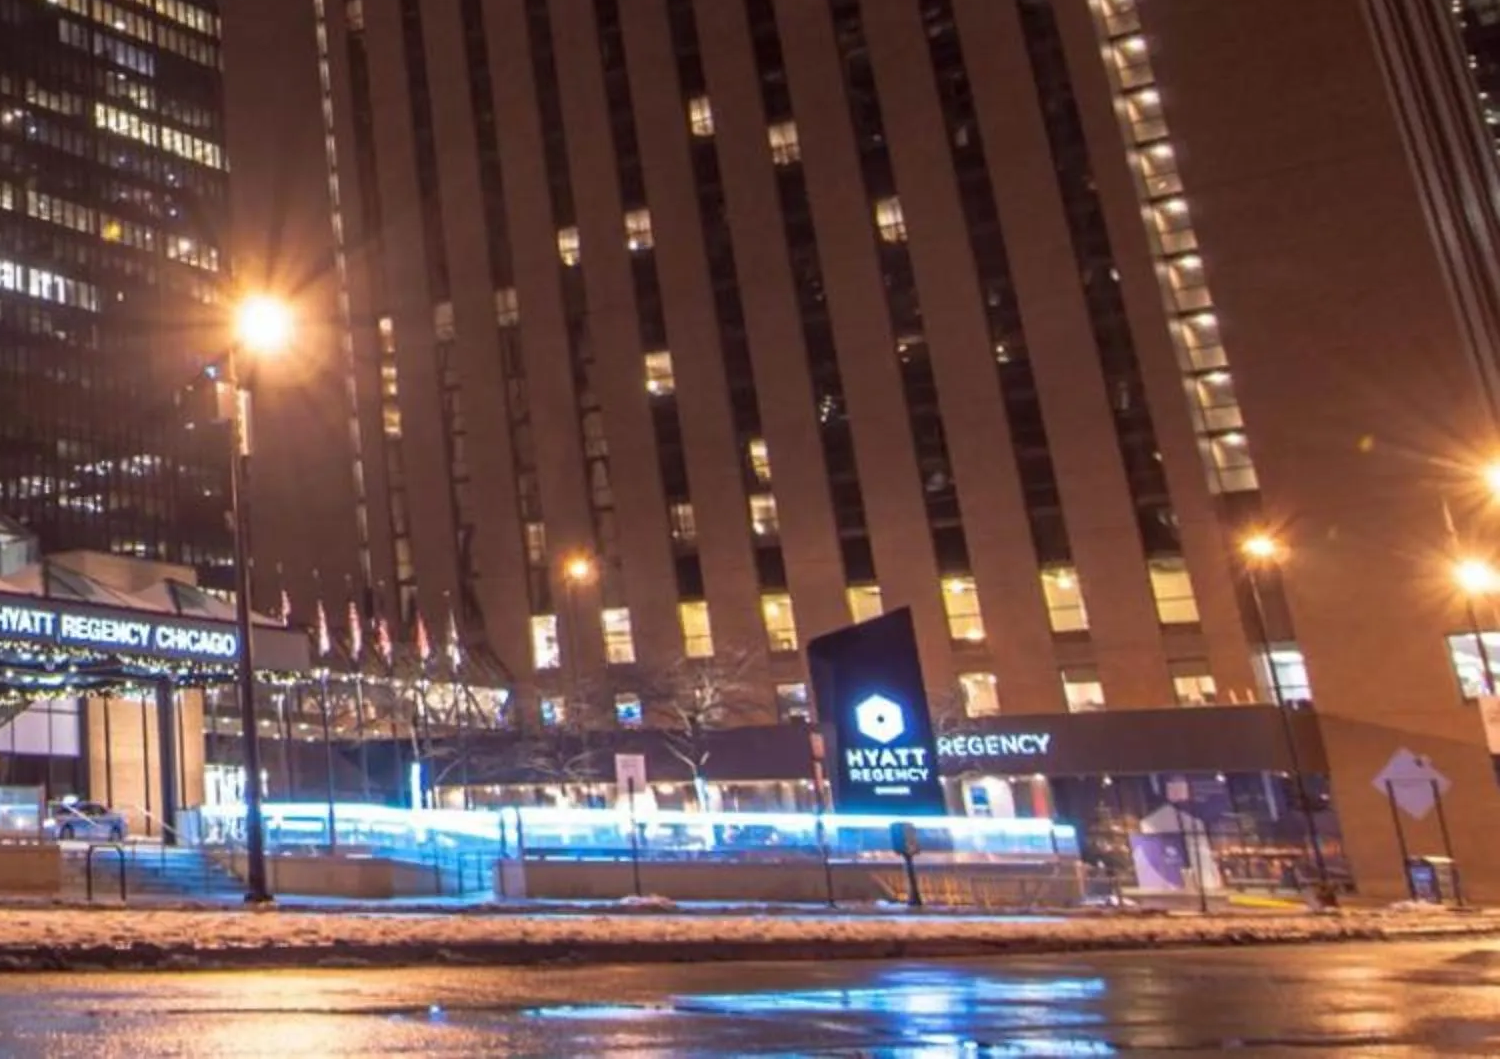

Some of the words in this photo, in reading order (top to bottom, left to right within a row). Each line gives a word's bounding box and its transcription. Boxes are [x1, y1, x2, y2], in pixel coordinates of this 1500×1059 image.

[60, 614, 151, 646] REGENCY
[155, 625, 237, 656] CHICAGO
[936, 733, 1051, 757] REGENCY
[846, 748, 927, 768] HYATT
[850, 768, 929, 782] REGENCY
